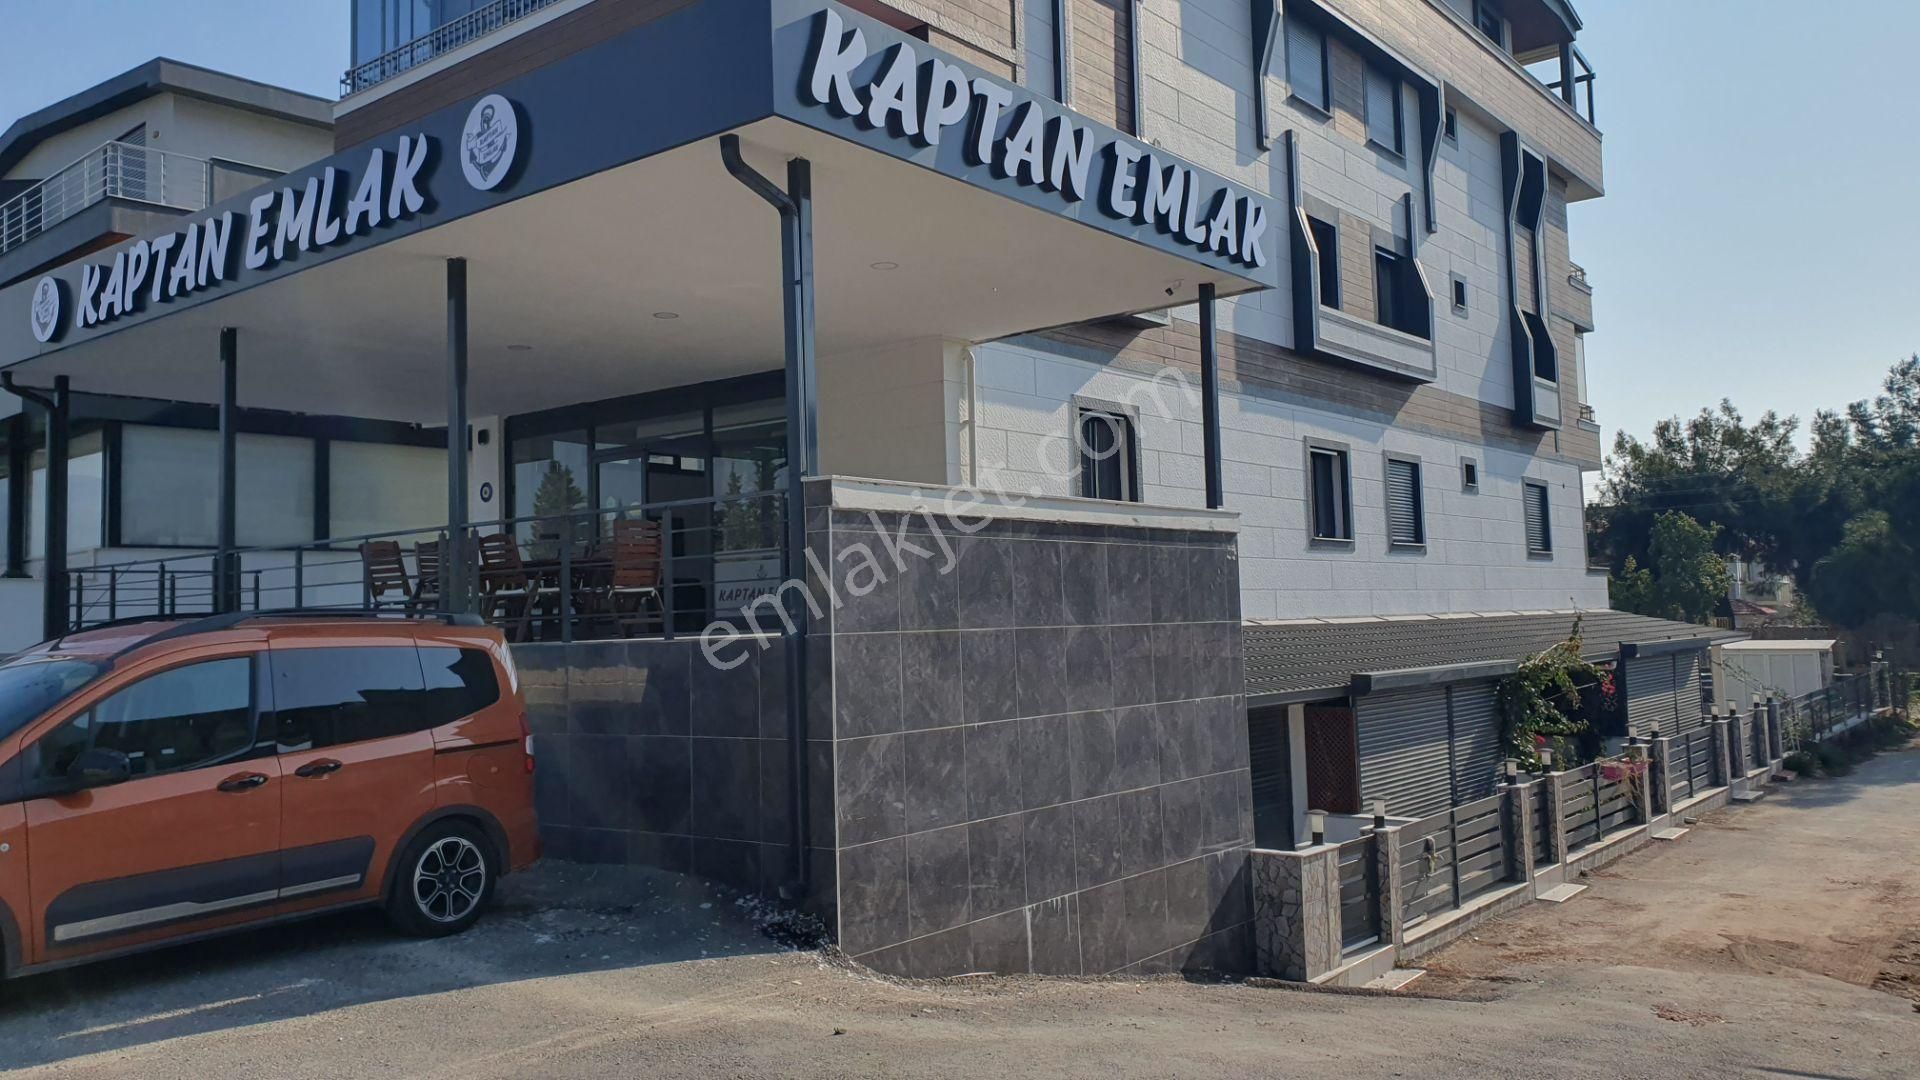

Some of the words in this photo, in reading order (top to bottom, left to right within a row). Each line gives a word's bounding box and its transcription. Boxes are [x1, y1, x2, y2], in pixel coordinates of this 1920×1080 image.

[76, 211, 232, 328] KAPTAN
[245, 133, 427, 269] EMLAK
[811, 8, 1094, 201] KAPTAN
[1110, 139, 1267, 268] EMLAK
